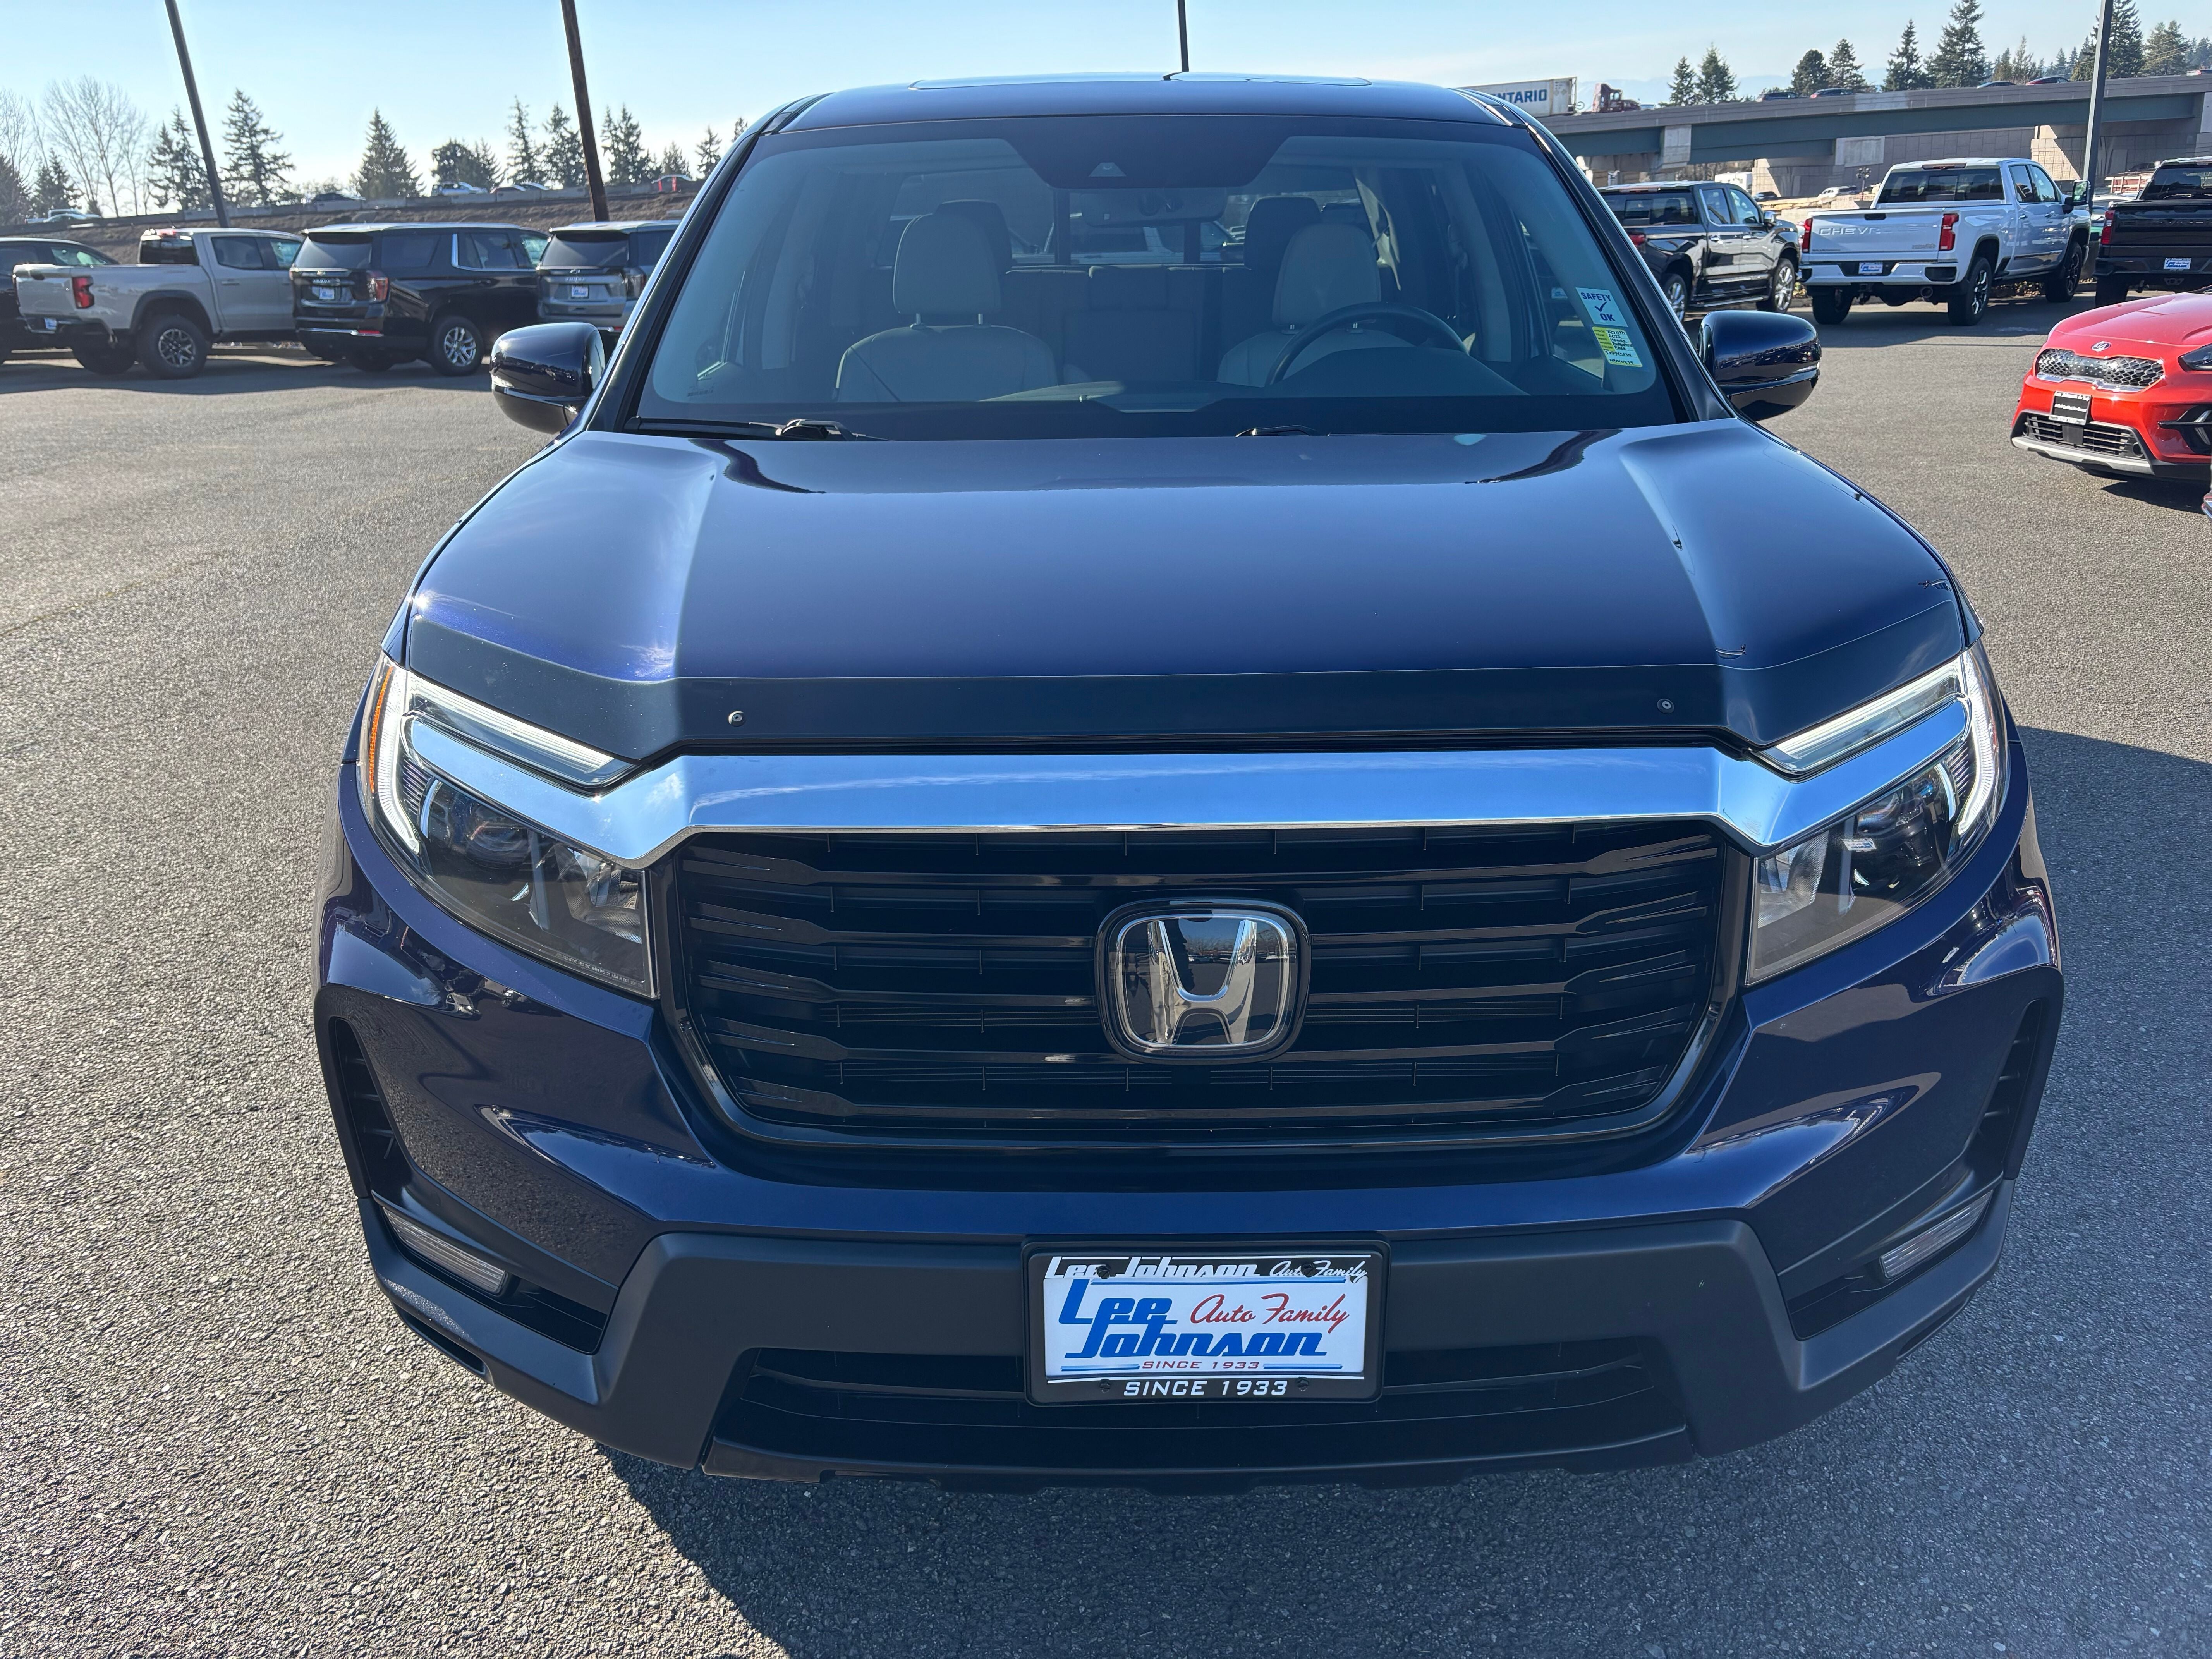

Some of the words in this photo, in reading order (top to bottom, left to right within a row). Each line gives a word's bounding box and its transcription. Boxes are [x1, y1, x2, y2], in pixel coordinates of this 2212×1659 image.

[1491, 89, 1547, 103] NTARIO
[1581, 292, 1611, 301] SAFETY
[1115, 1256, 1260, 1278] Johnson
[1269, 1261, 1305, 1277] Aut
[1313, 1260, 1367, 1283] Family
[1058, 1279, 1178, 1324] Lee
[1190, 1294, 1256, 1324] Auto
[1261, 1293, 1350, 1334] Family
[1065, 1319, 1327, 1358] Johnson
[1142, 1361, 1202, 1369] SINCE
[1124, 1381, 1207, 1396] SINCE
[1222, 1380, 1288, 1395] 1933
